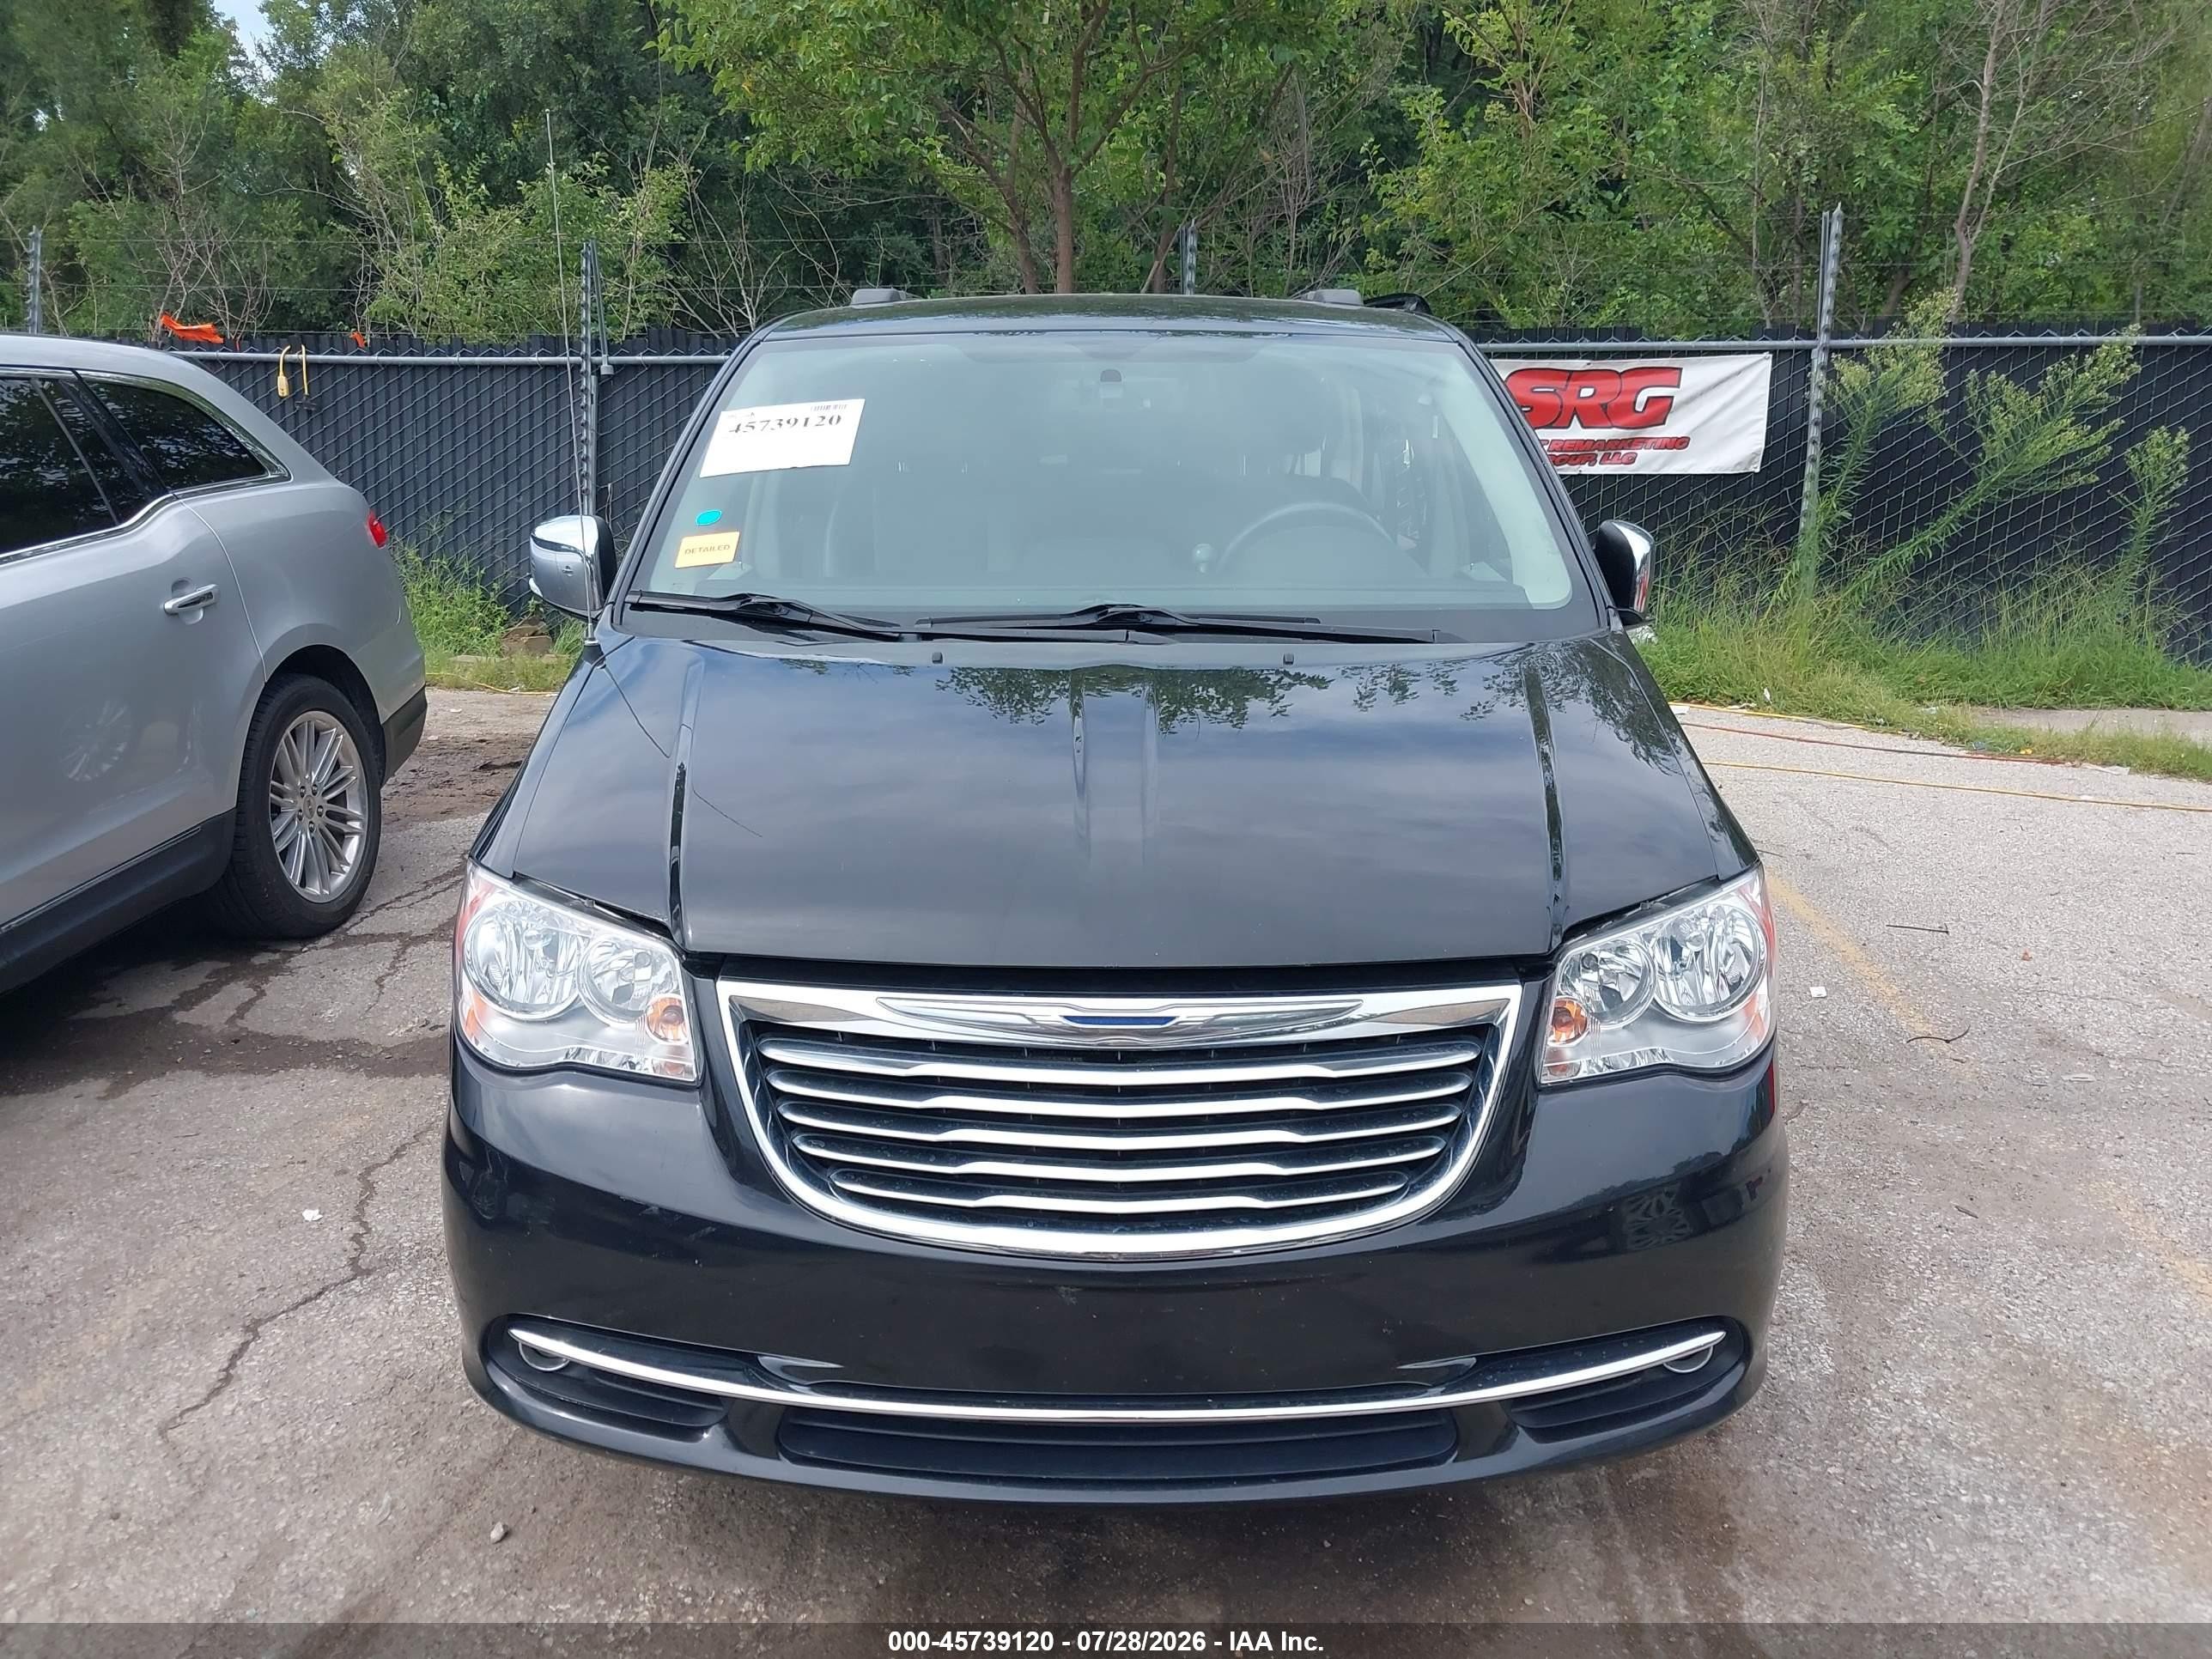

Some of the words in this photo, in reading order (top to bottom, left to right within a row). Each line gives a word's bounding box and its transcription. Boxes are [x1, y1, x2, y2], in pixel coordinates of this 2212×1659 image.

[1505, 367, 1683, 429] SRG
[728, 415, 842, 434] 45739120
[1547, 436, 1691, 452] REMARKETING
[1599, 453, 1638, 465] LLC
[684, 544, 731, 555] DETAILED
